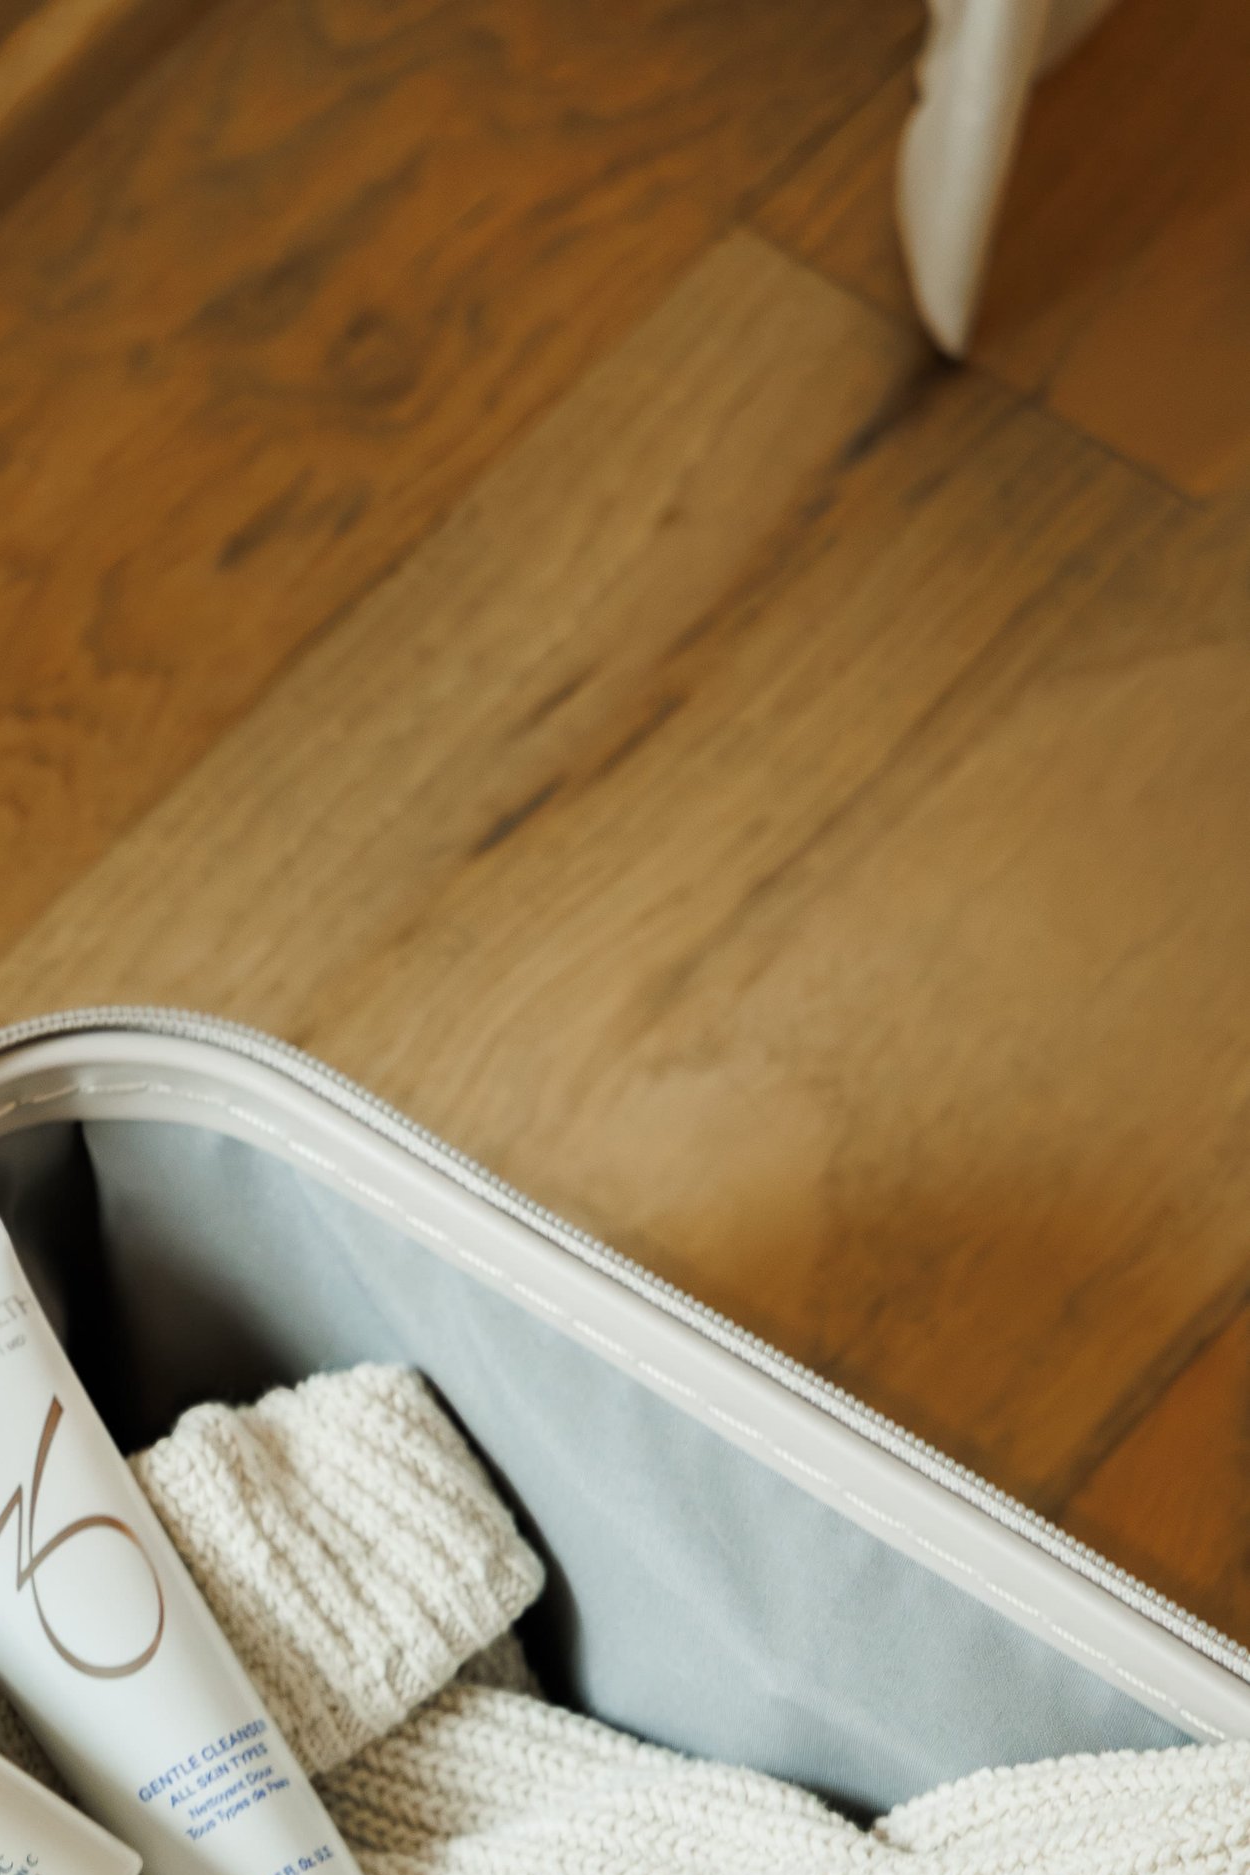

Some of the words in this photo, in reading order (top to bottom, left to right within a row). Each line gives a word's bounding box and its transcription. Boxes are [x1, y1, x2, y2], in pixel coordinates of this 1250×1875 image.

[138, 1754, 201, 1803] GENTLE
[170, 1786, 196, 1809] ALL
[196, 1762, 230, 1789] SKIN
[228, 1741, 269, 1769] TYPES
[215, 1796, 252, 1822] Types
[25, 1853, 39, 1868] C
